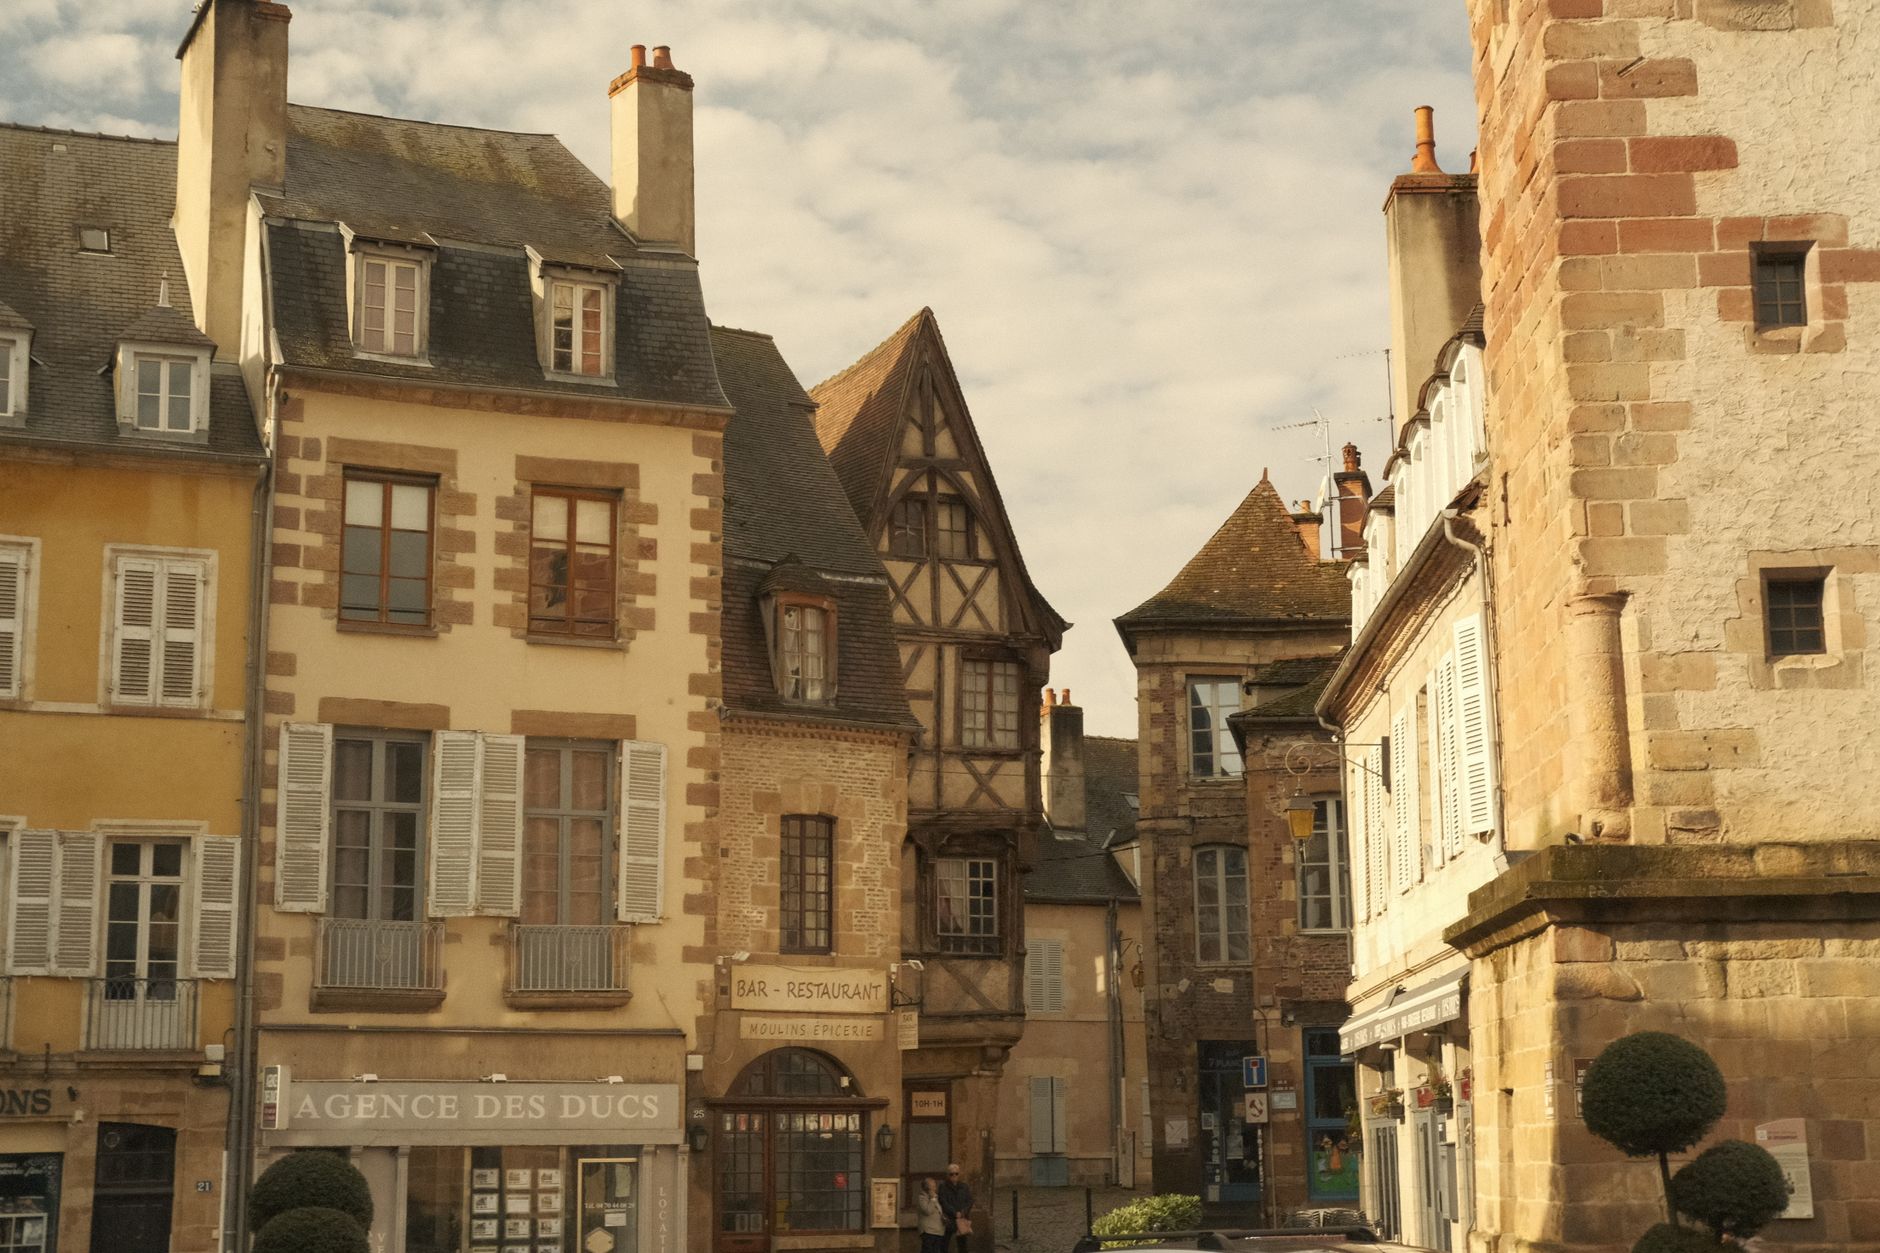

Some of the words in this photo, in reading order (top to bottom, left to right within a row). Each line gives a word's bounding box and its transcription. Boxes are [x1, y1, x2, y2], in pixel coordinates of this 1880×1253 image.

[736, 980, 768, 998] BAR
[787, 981, 881, 1000] RESTAURANT
[750, 1023, 806, 1036] MOULINS
[813, 1021, 873, 1036] ÉPICERIE
[0, 1089, 52, 1115] NS
[294, 1094, 460, 1119] AGENCE
[474, 1094, 546, 1119] DES
[559, 1094, 659, 1119] DUCS
[914, 1100, 944, 1108] 10H-1H
[693, 1109, 705, 1119] 25
[197, 1182, 210, 1192] 21
